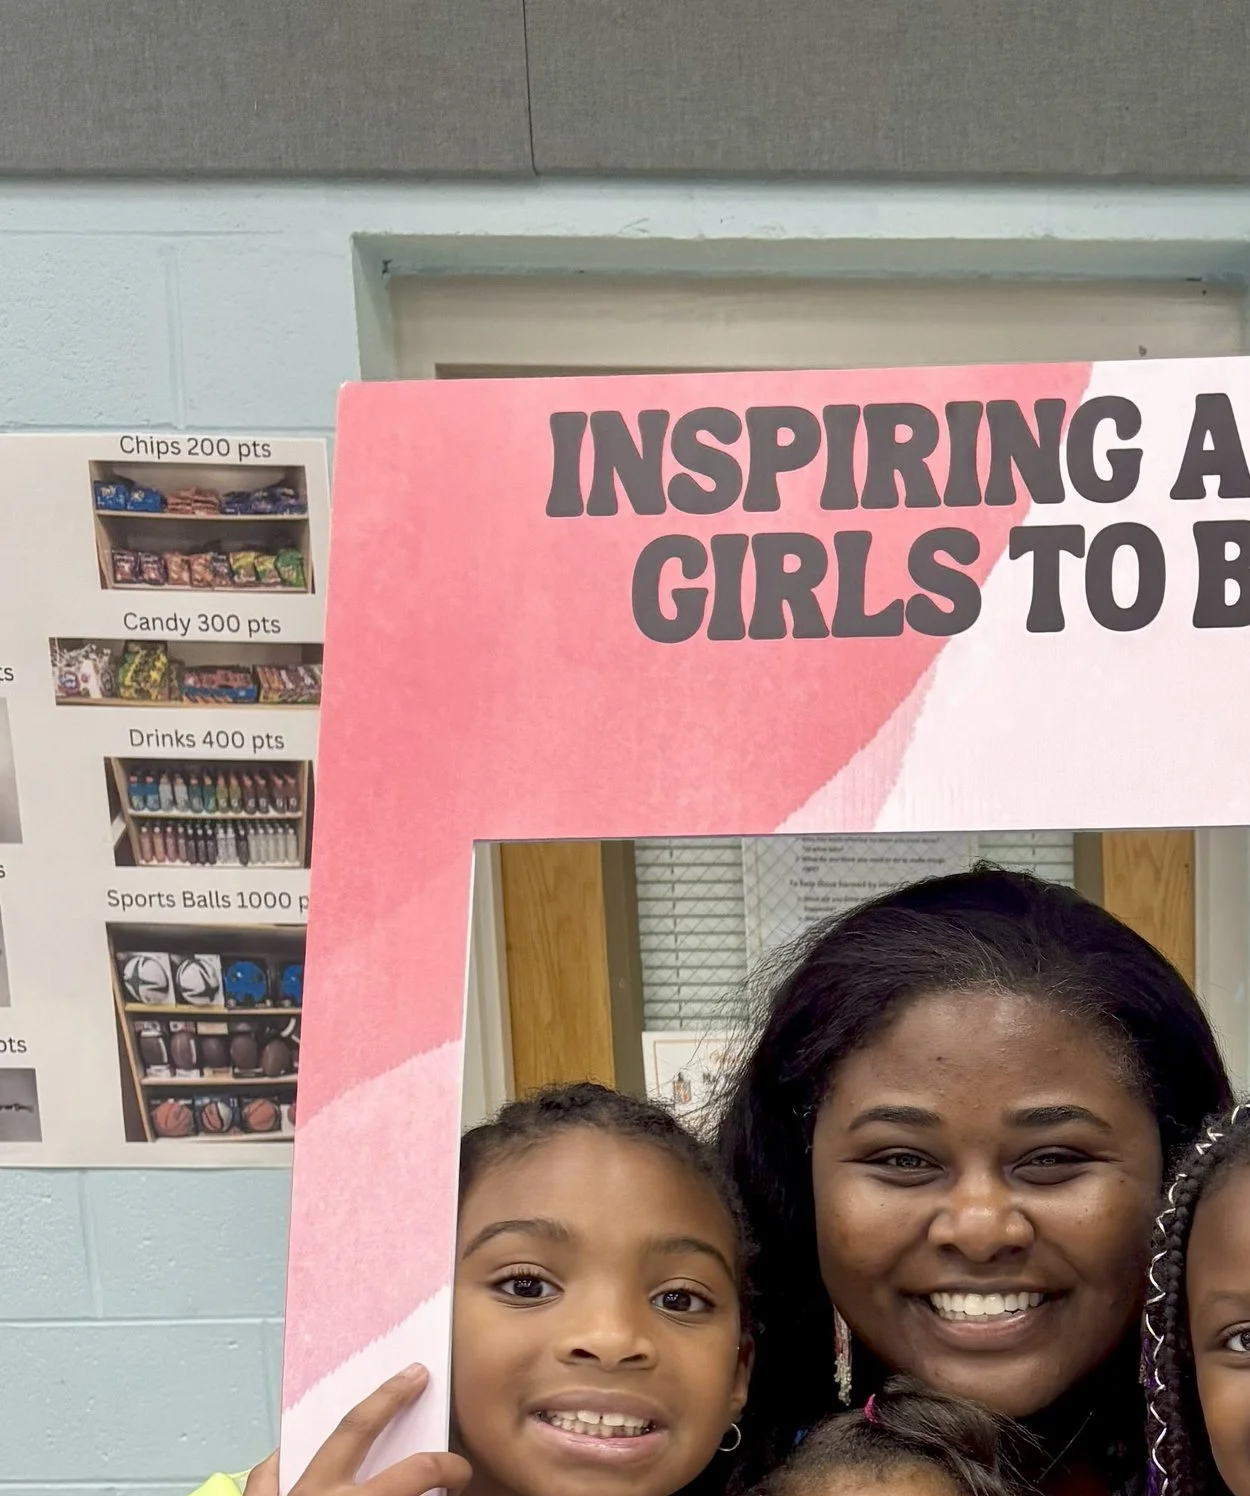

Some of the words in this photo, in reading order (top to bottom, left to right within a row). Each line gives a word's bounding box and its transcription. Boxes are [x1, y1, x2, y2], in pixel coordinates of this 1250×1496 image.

[119, 434, 182, 460] Chips
[186, 437, 231, 458] 200
[237, 439, 272, 462] pts
[546, 396, 1143, 517] INSPIRING
[632, 527, 981, 643] GIRLS
[1010, 522, 1165, 632] TO
[123, 612, 191, 636] Candy
[197, 614, 241, 634] 300
[247, 615, 282, 638] pts
[129, 728, 196, 749] Drinks
[202, 730, 245, 750] 400
[252, 732, 285, 754] pts
[106, 889, 176, 912] Sports
[182, 890, 232, 910] Balls
[236, 891, 292, 910] 1000
